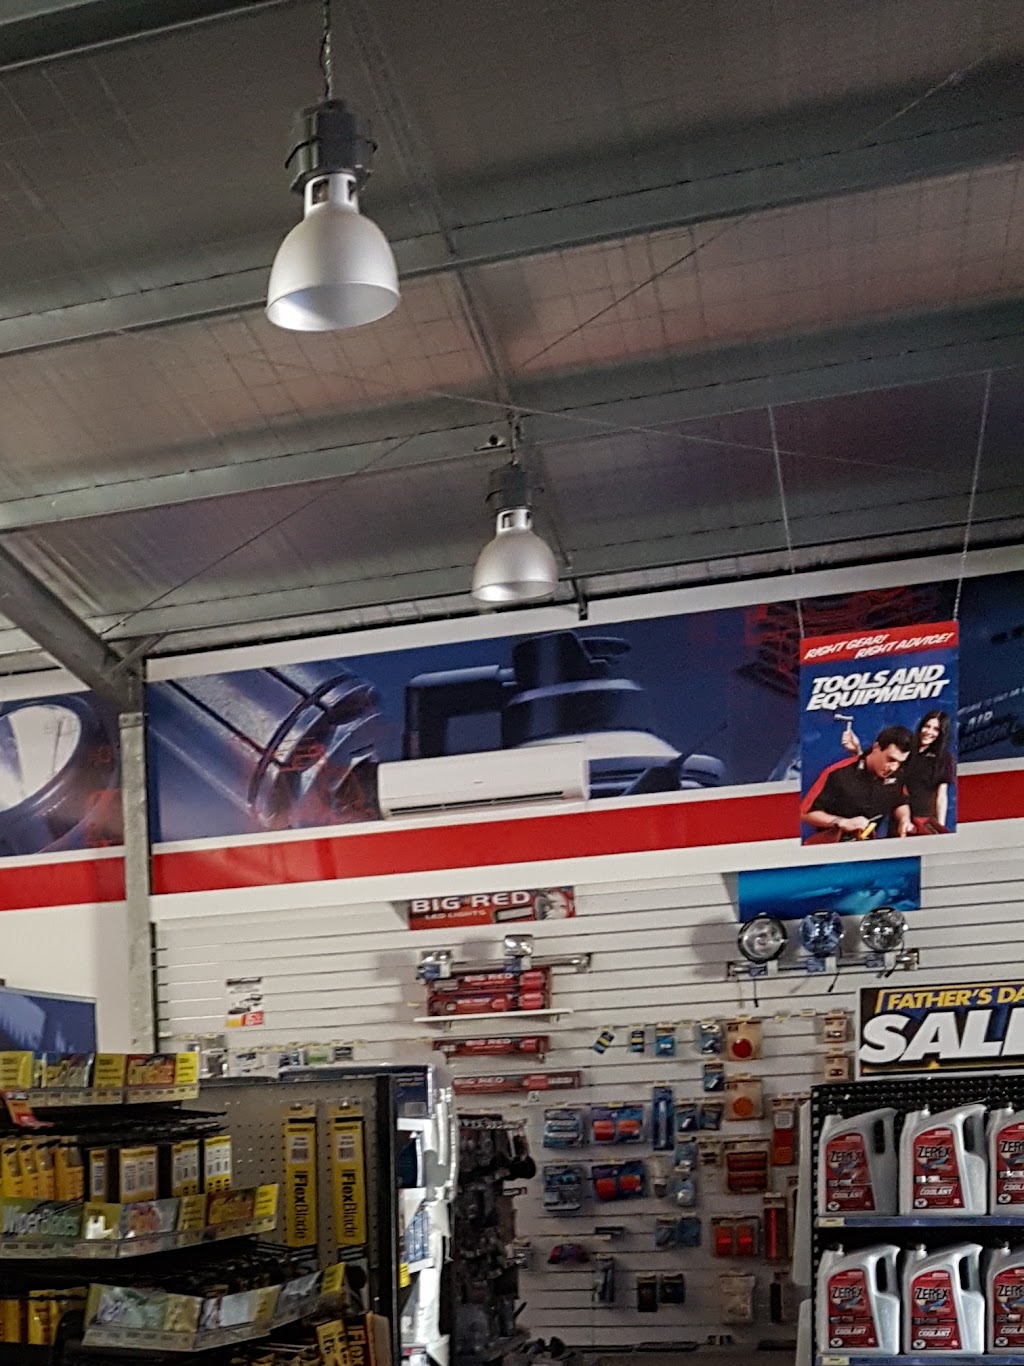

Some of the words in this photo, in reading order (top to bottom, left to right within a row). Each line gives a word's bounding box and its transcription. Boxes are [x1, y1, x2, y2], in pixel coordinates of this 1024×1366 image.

[803, 641, 844, 660] RIGHT
[845, 634, 890, 653] GEAR!
[854, 643, 893, 660] RIGHT
[893, 632, 954, 653] ADVICE!
[812, 669, 888, 695] TOOLS
[887, 664, 946, 686] AND
[806, 679, 951, 712] EQUIPMENT
[412, 897, 461, 913] BIG
[471, 891, 531, 908] RED
[887, 987, 994, 1010] FATHER'S
[831, 1151, 862, 1163] ZEREX
[918, 1146, 951, 1159] ZEREX
[831, 1286, 863, 1300] ZEREX
[915, 1287, 949, 1300] ZEREX
